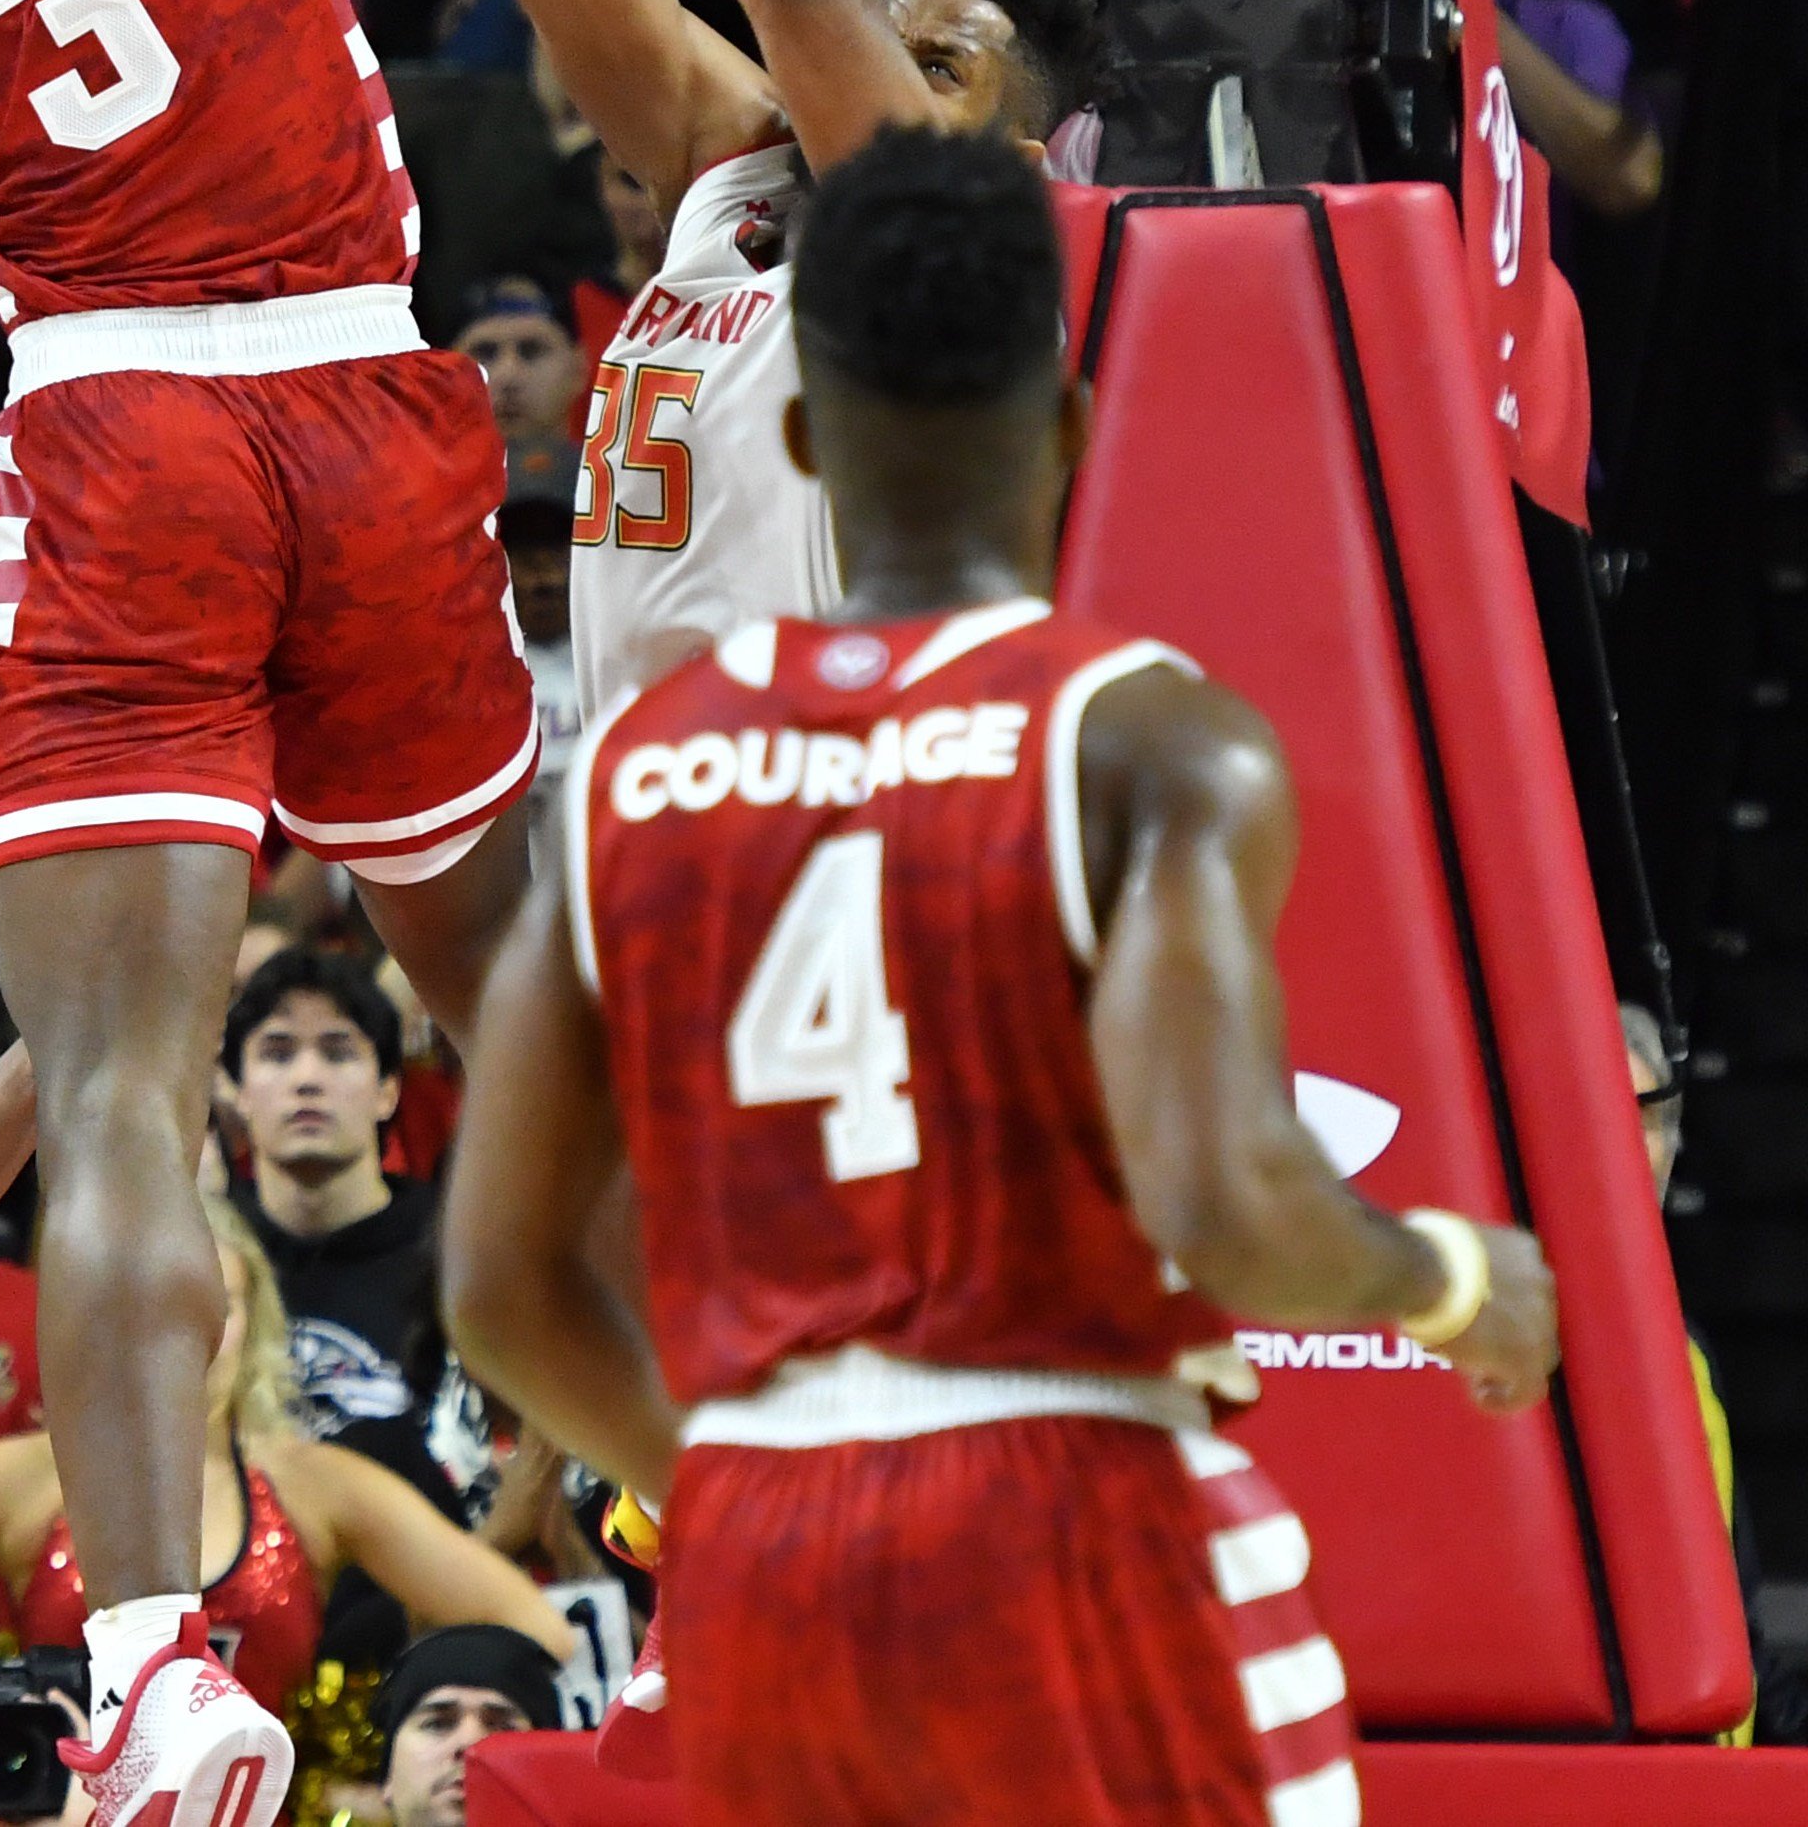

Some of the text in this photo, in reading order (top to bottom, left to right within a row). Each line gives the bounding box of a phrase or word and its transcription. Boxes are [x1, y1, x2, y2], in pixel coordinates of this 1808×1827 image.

[572, 360, 705, 552] 35
[611, 701, 1031, 821] COURAGE
[726, 830, 921, 1184] 4
[1233, 1330, 1453, 1371] RMOUR
